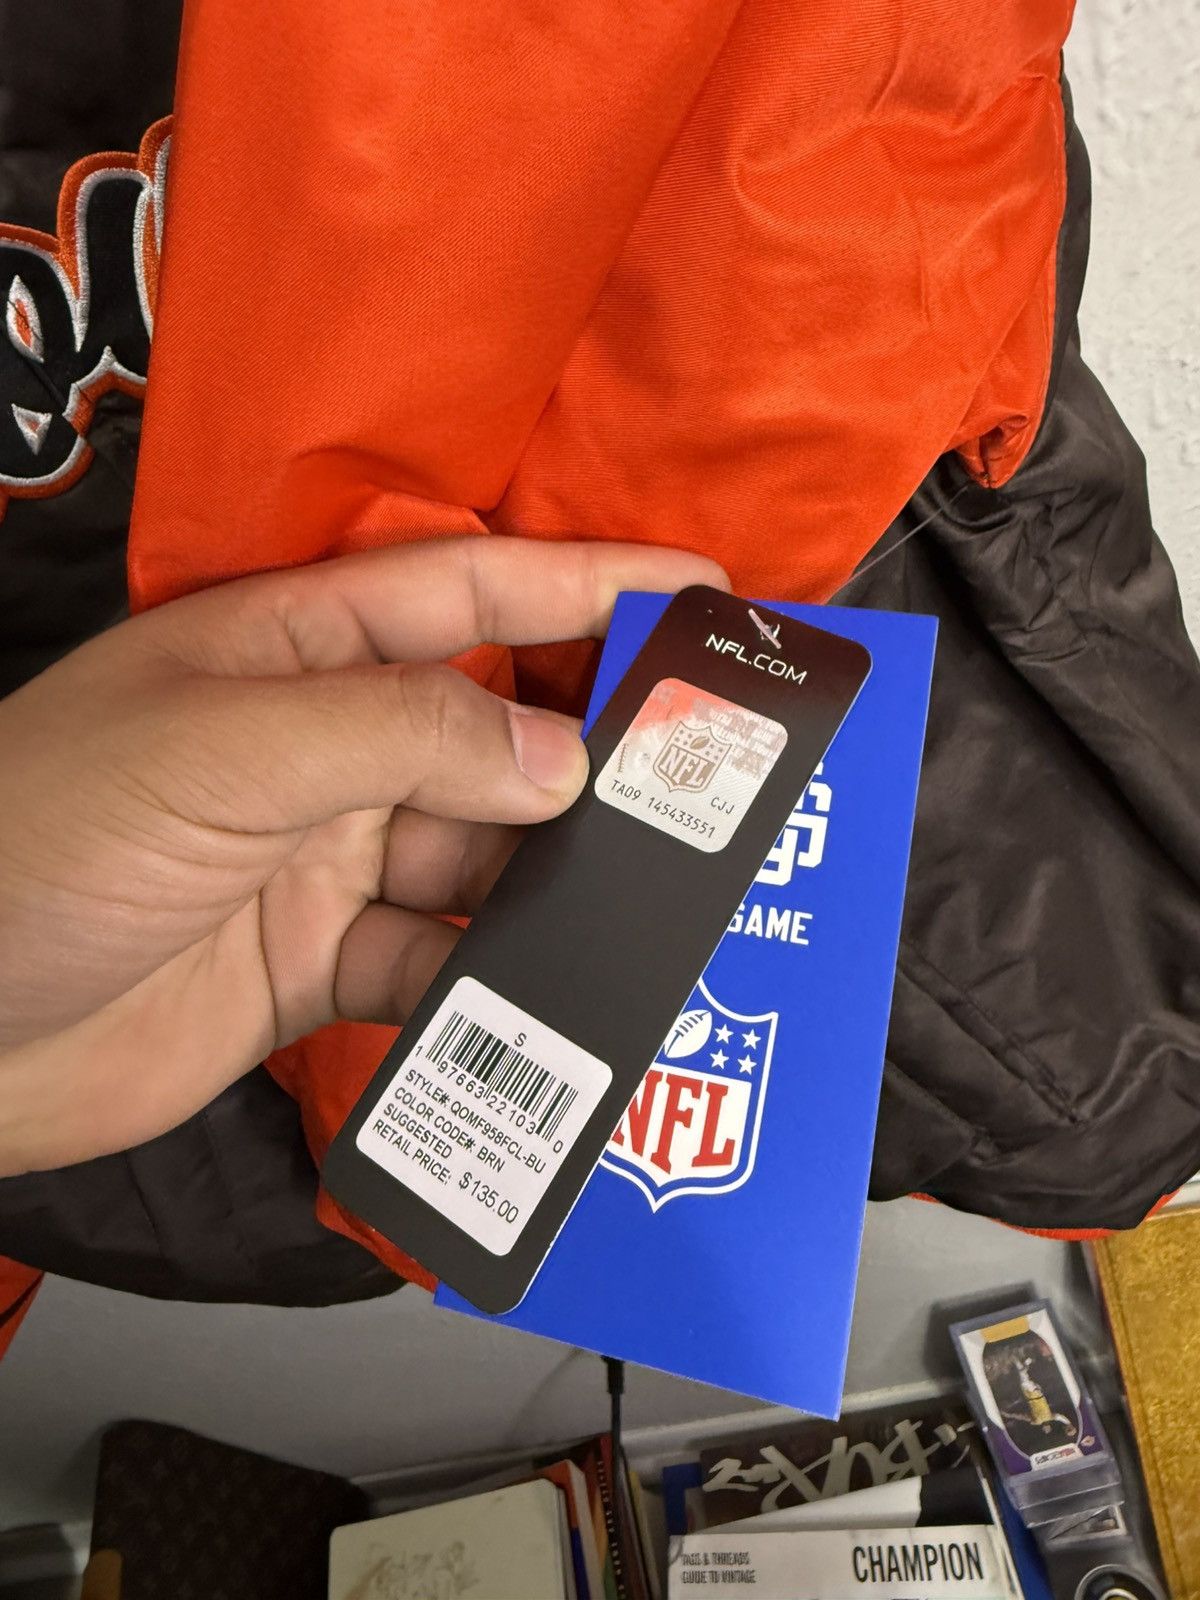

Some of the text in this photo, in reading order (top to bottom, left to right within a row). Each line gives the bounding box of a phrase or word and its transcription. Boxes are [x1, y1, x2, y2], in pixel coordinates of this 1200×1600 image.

[705, 633, 808, 686] NFL.COM
[659, 745, 710, 788] NFL
[609, 779, 717, 839] TA09 145433551
[710, 797, 735, 815] CJJ
[514, 1032, 528, 1047] S
[405, 1069, 547, 1174] STYLE#: QOMF958FCL-BU
[415, 1045, 424, 1057] 1
[552, 1140, 564, 1154] 0
[611, 1069, 736, 1175] NFL
[372, 1120, 452, 1185] RETAIL PRICE:
[383, 1103, 453, 1160] SUGGESTED
[394, 1087, 506, 1173] COLOR CODE#: BRN
[458, 1171, 520, 1224] $135.00
[852, 1542, 984, 1583] CHAMPION
